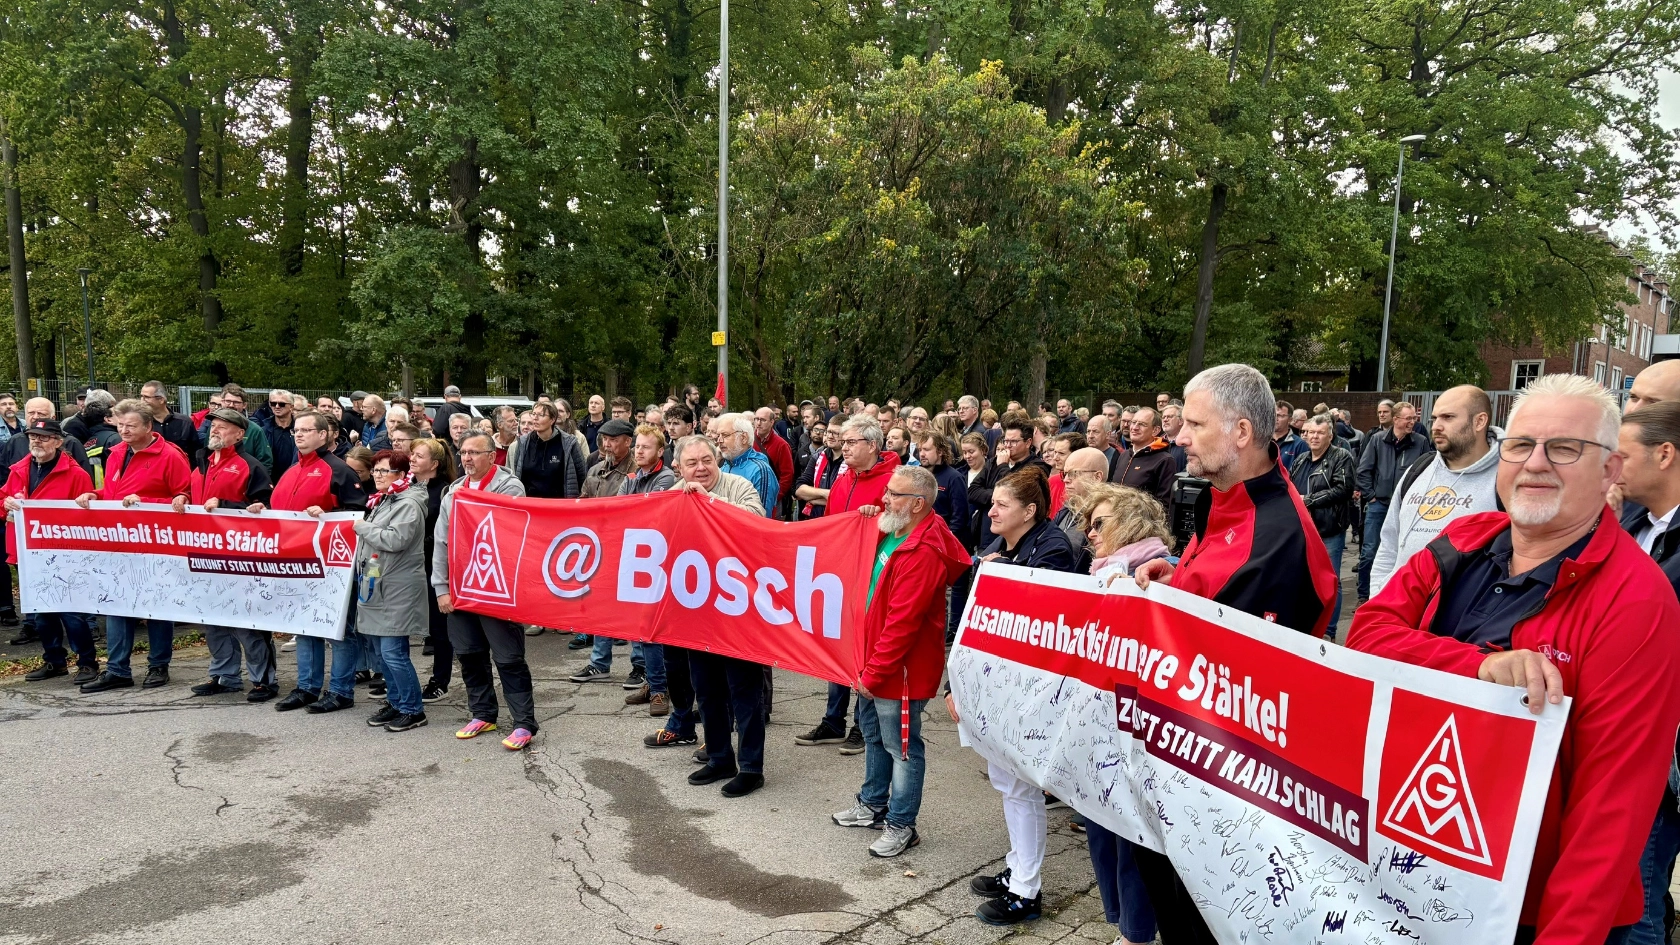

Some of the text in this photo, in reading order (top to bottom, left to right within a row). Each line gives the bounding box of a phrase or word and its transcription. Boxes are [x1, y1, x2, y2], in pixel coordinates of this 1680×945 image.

[29, 519, 280, 555] Zusammenhalt ist unsere Stärke!
[1407, 492, 1473, 509] Hard Rock
[189, 557, 321, 576] ZUKUNFT STATT KAHLSCHLAG
[541, 525, 844, 639] @ Bosch
[1106, 635, 1179, 690] unere
[1177, 653, 1289, 749] Stärke!
[1157, 721, 1225, 771] STATT
[1218, 750, 1361, 847] KAHLSCHLAG
[1394, 737, 1475, 851] IGM
